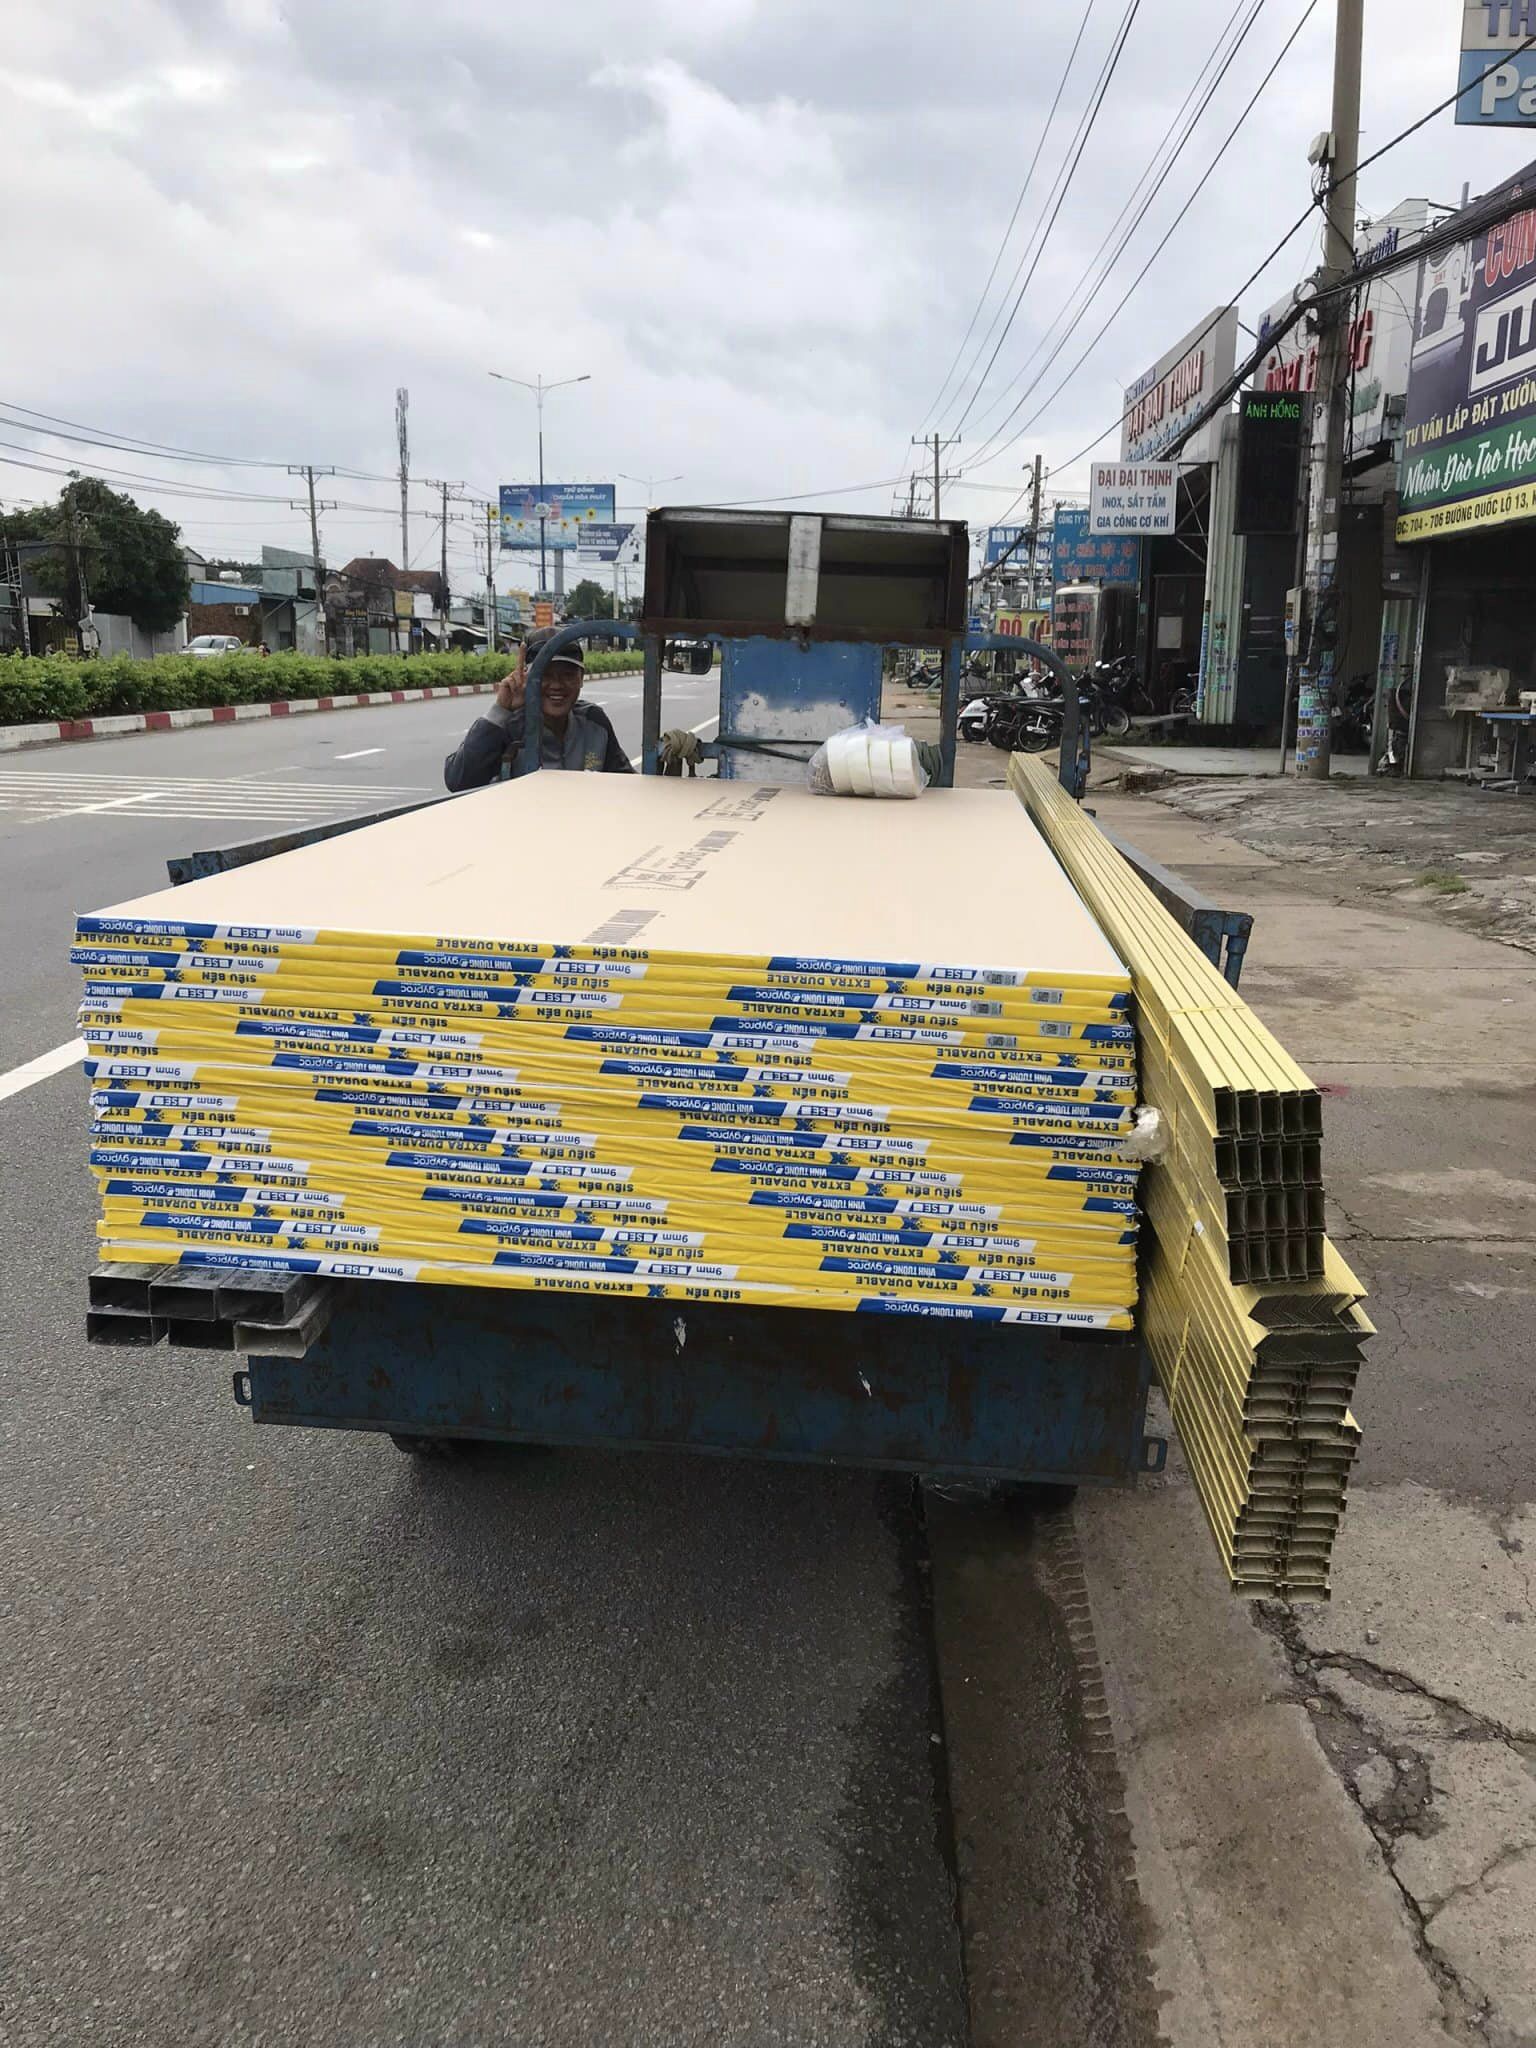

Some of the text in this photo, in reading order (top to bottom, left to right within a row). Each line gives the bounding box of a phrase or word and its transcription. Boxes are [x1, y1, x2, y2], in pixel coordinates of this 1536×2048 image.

[1422, 413, 1443, 443] VẤN
[1446, 403, 1469, 434] LẮP
[1472, 396, 1498, 426] ĐẶT
[1403, 459, 1441, 500] Nhận
[1441, 452, 1474, 492] Đào
[1475, 441, 1502, 479] Tạo
[1098, 469, 1172, 490] ĐẠI ĐẠI THỊNH
[1128, 492, 1144, 508] SẮT
[1147, 492, 1166, 508] TẤM
[1096, 516, 1111, 527] GIA
[1113, 513, 1137, 527] CÔNG
[1154, 512, 1169, 527] KHÍ
[1410, 517, 1422, 532] 704
[1430, 512, 1443, 529] 706
[1445, 504, 1472, 525] ĐƯỜNG
[1474, 496, 1498, 519] QUỐC
[75, 933, 129, 945] DURABLE
[135, 936, 172, 947] EXTRA
[436, 939, 493, 950] DURABLE
[499, 942, 538, 953] EXTRA
[767, 974, 824, 986] DURABLE
[830, 978, 870, 989] EXTRA
[382, 998, 438, 1009] DURABLE
[443, 1002, 483, 1012] EXTRA
[637, 1079, 694, 1089] DURABLE
[699, 1082, 738, 1092] EXTRA
[973, 1083, 1079, 1097] EXTRA DURABLE
[354, 1107, 410, 1118] DURABLE
[415, 1111, 454, 1121] EXTRA
[177, 1230, 231, 1242] DURABLE
[235, 1233, 273, 1244] EXTRA
[535, 1278, 590, 1290] DURABLE
[594, 1282, 633, 1292] EXTRA
[856, 1276, 912, 1288] DURABLE
[919, 1280, 958, 1290] EXTRA
